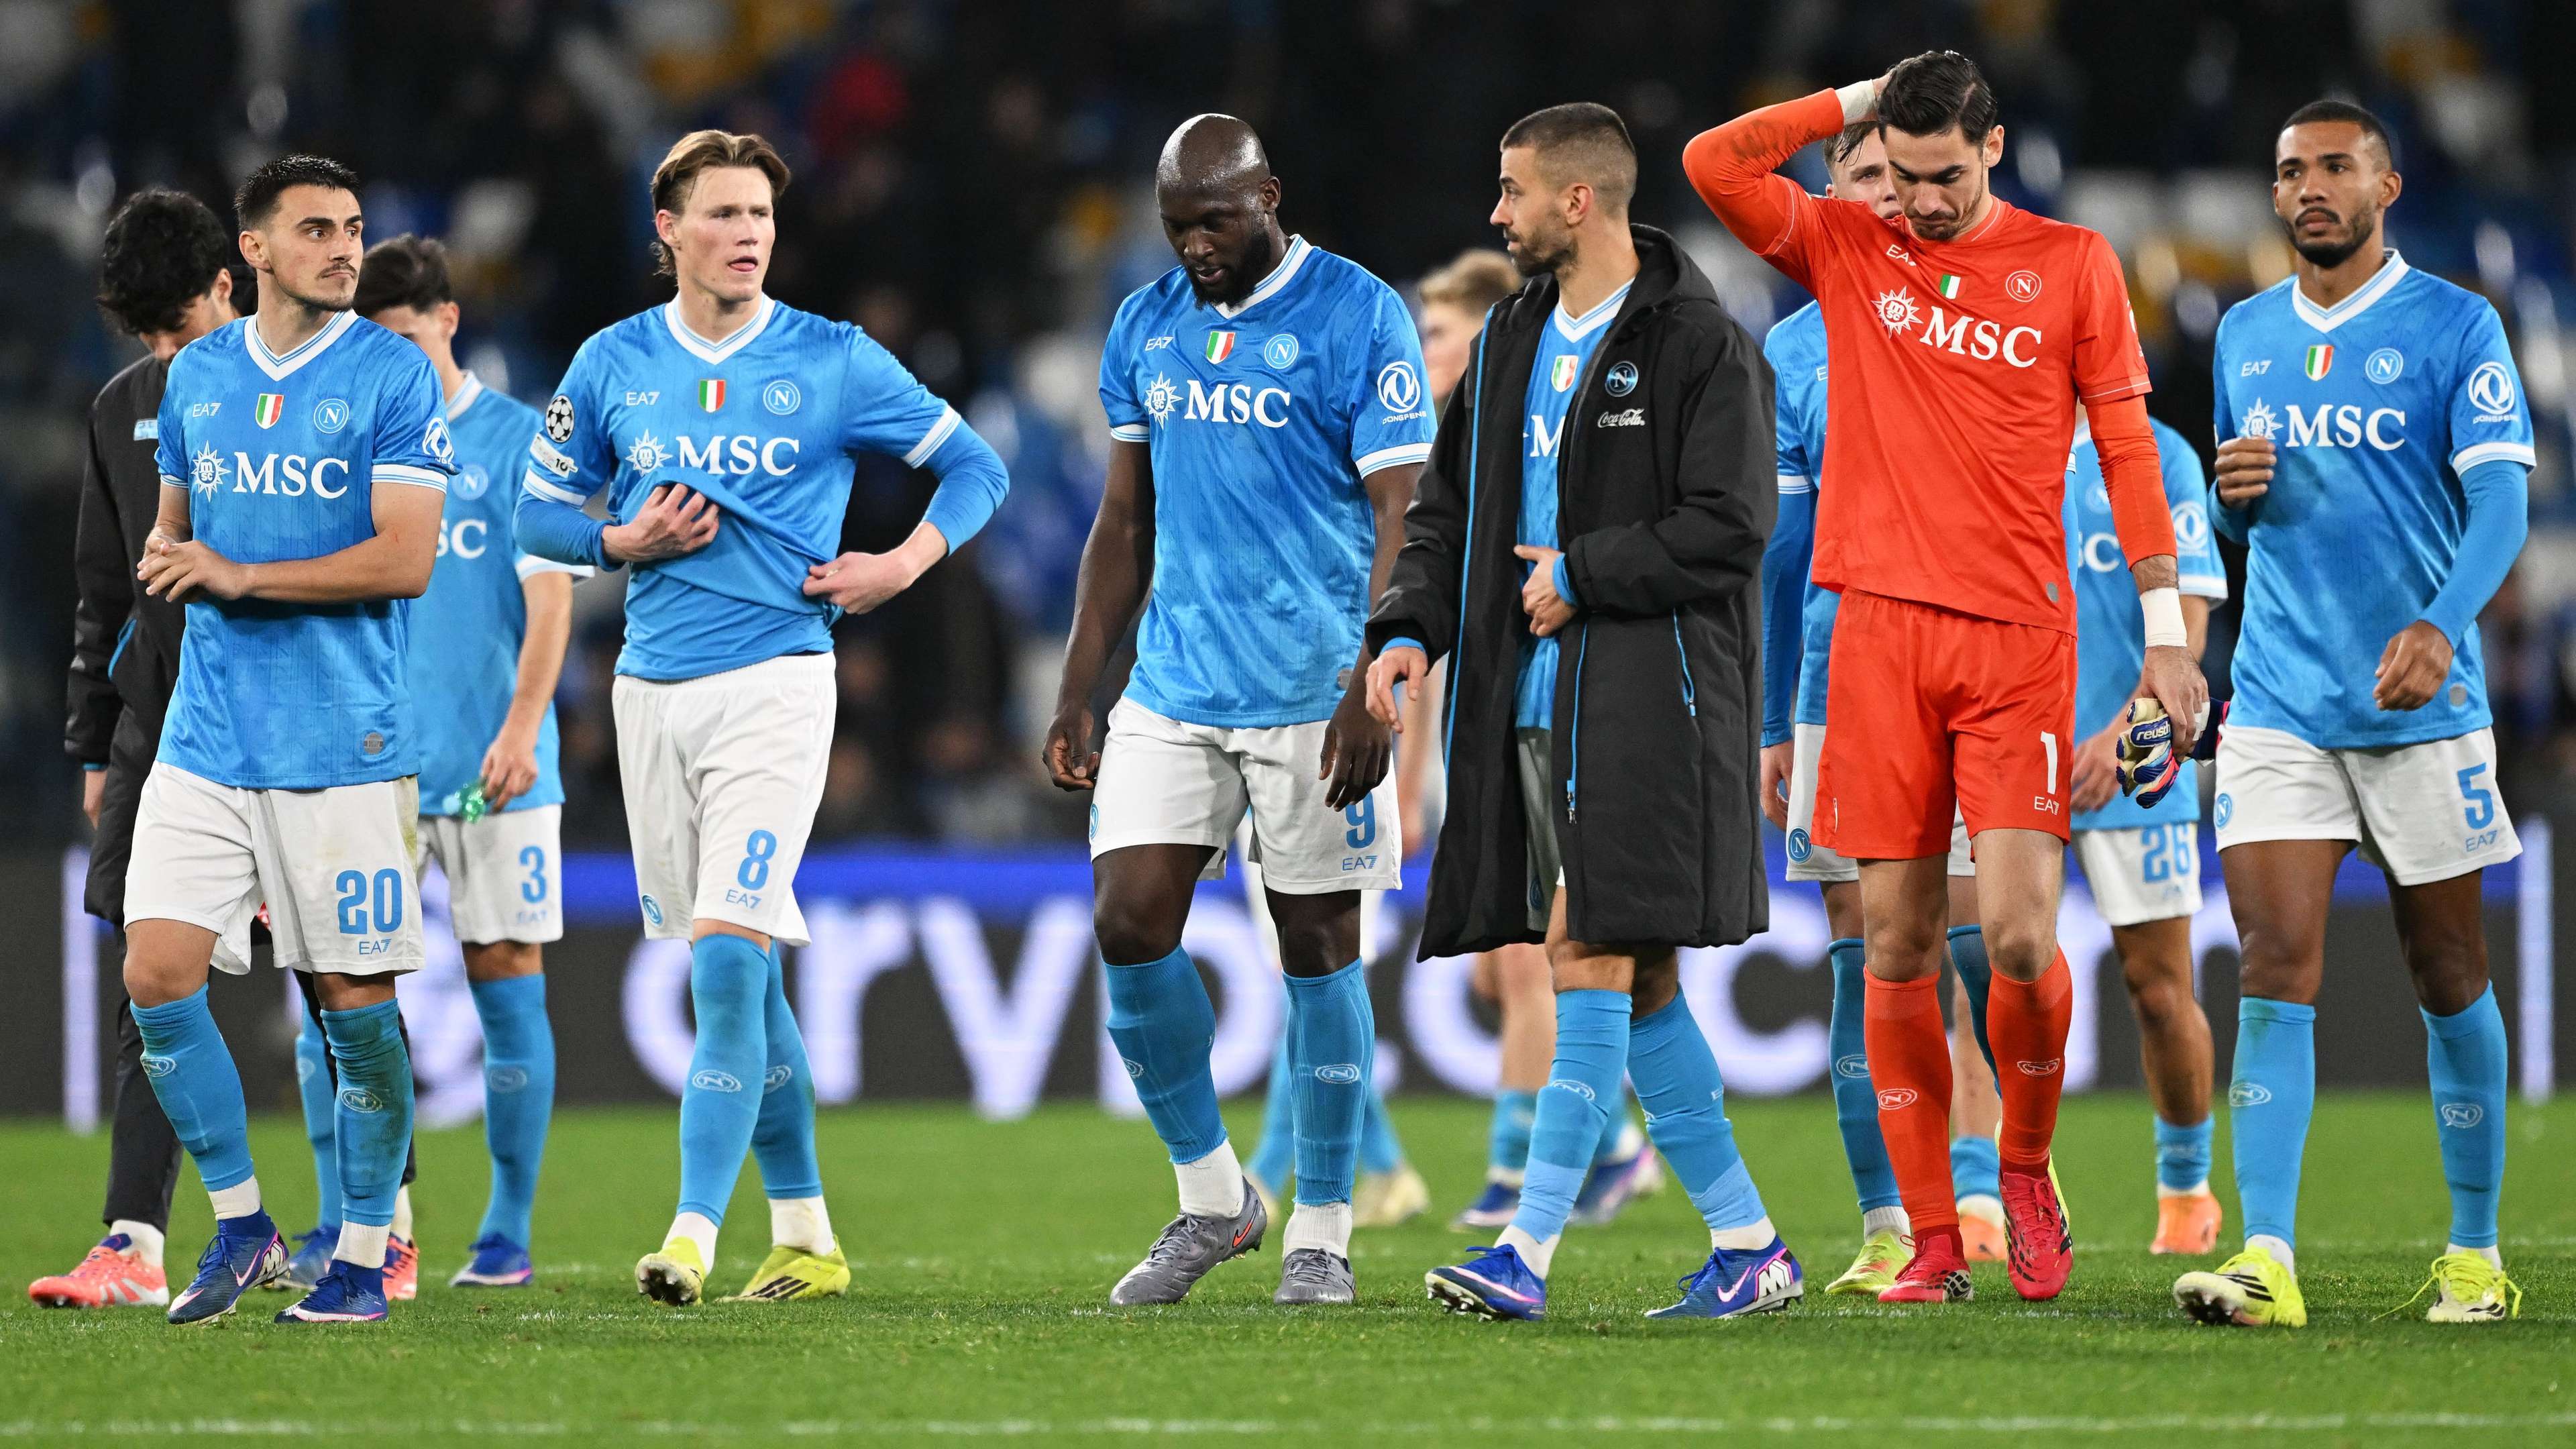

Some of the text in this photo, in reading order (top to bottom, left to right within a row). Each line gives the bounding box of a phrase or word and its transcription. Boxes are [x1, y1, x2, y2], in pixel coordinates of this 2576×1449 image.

[1886, 244, 1917, 267] EA
[1144, 336, 1174, 352] EA7
[1919, 305, 2042, 368] MSC
[2241, 360, 2272, 377] EA7
[192, 402, 221, 418] EA7
[626, 392, 660, 406] EA7
[1184, 380, 1291, 428] MSC
[1382, 411, 1428, 425] DONGFENG
[2285, 404, 2406, 451] MSC
[232, 451, 349, 499] MSC
[676, 436, 800, 476] MSC
[2040, 731, 2058, 794] 1
[2457, 762, 2494, 830] 5
[1345, 791, 1376, 849] 9
[2465, 830, 2498, 852] EA7
[519, 845, 547, 904] 3
[737, 829, 777, 891] 8
[1342, 855, 1378, 871] EA7
[2141, 824, 2191, 883] 26
[336, 868, 402, 934] 20
[725, 890, 762, 909] EA7
[359, 938, 392, 955] EA7
